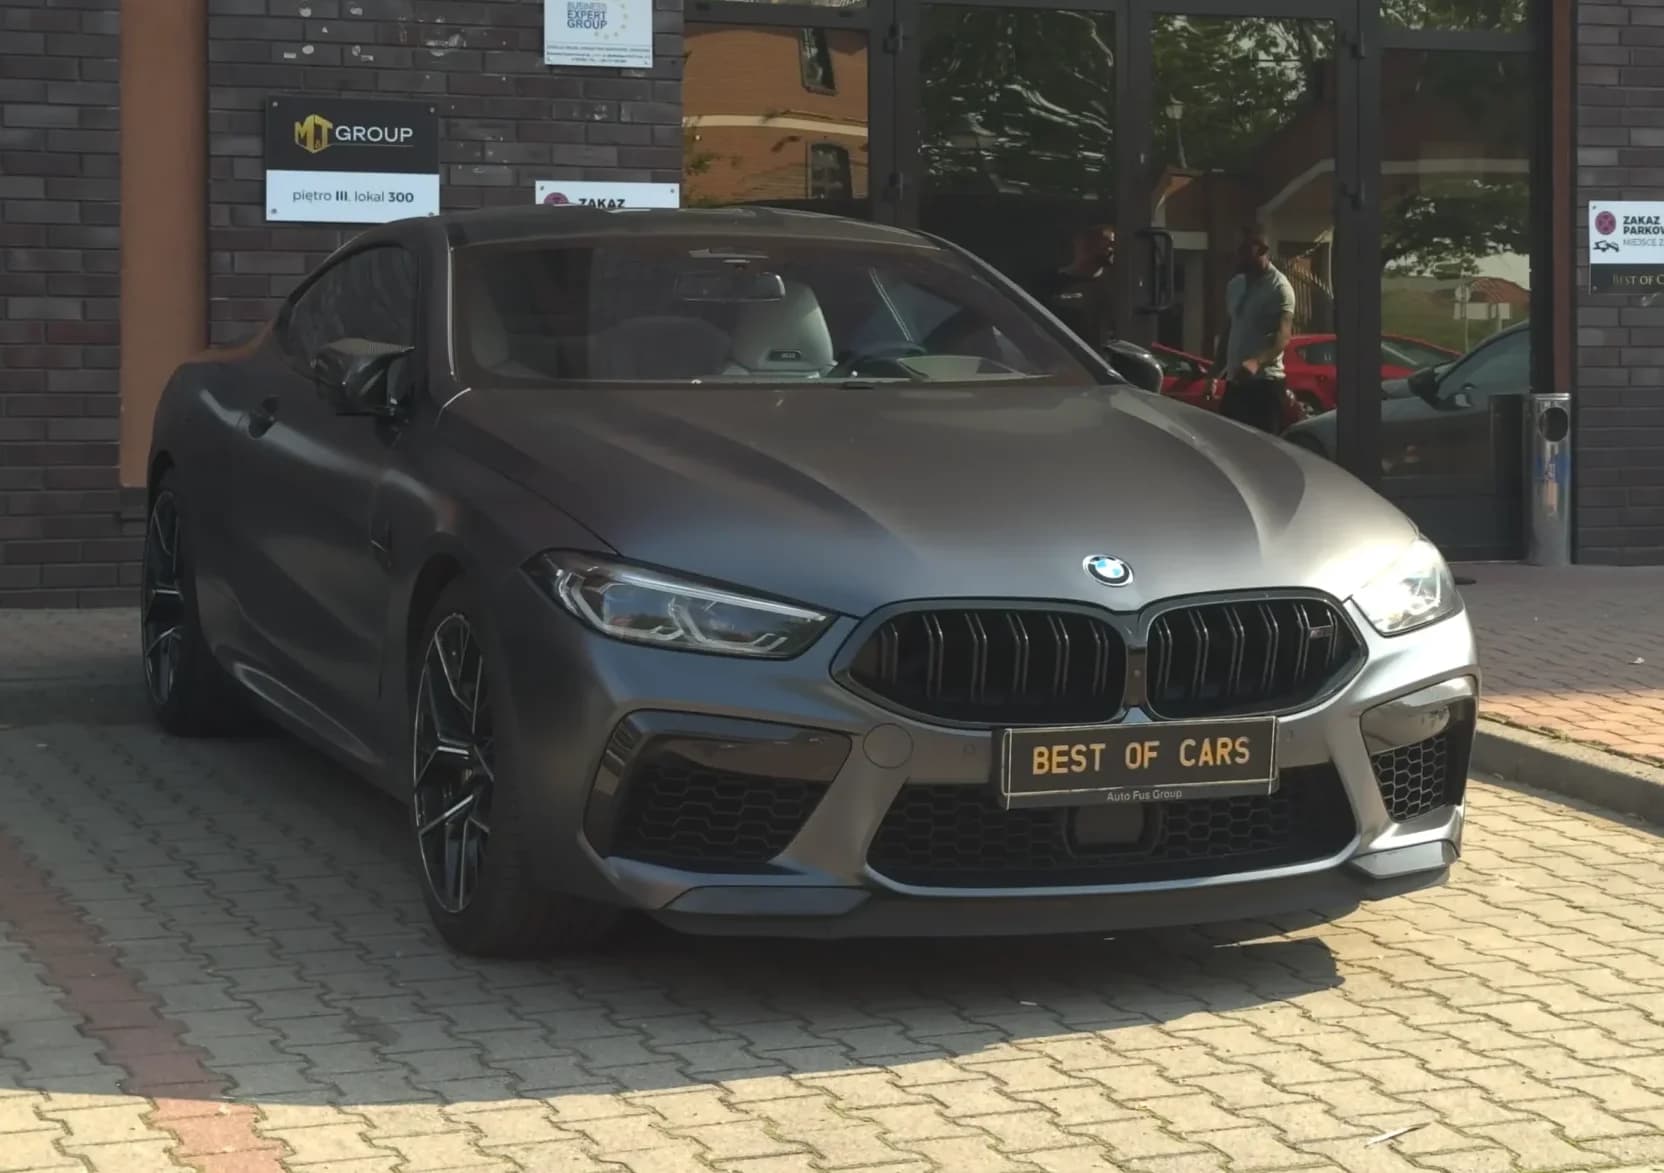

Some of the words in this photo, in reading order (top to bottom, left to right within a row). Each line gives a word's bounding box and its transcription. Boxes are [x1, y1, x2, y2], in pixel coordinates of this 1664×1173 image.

[567, 10, 606, 20] EXPERT
[567, 19, 607, 30] GROUP
[335, 125, 413, 142] GROUP
[292, 189, 332, 203] piętro
[354, 191, 384, 202] lokal
[388, 192, 414, 203] 300
[1623, 216, 1660, 225] ZAKAZ
[1612, 275, 1635, 285] BEST
[1640, 276, 1654, 285] OF
[1032, 743, 1105, 775] BEST
[1125, 741, 1160, 769] OF
[1180, 736, 1250, 767] CARS
[1107, 791, 1131, 801] Auto
[1133, 790, 1151, 800] Fus
[1153, 789, 1183, 801] Group
